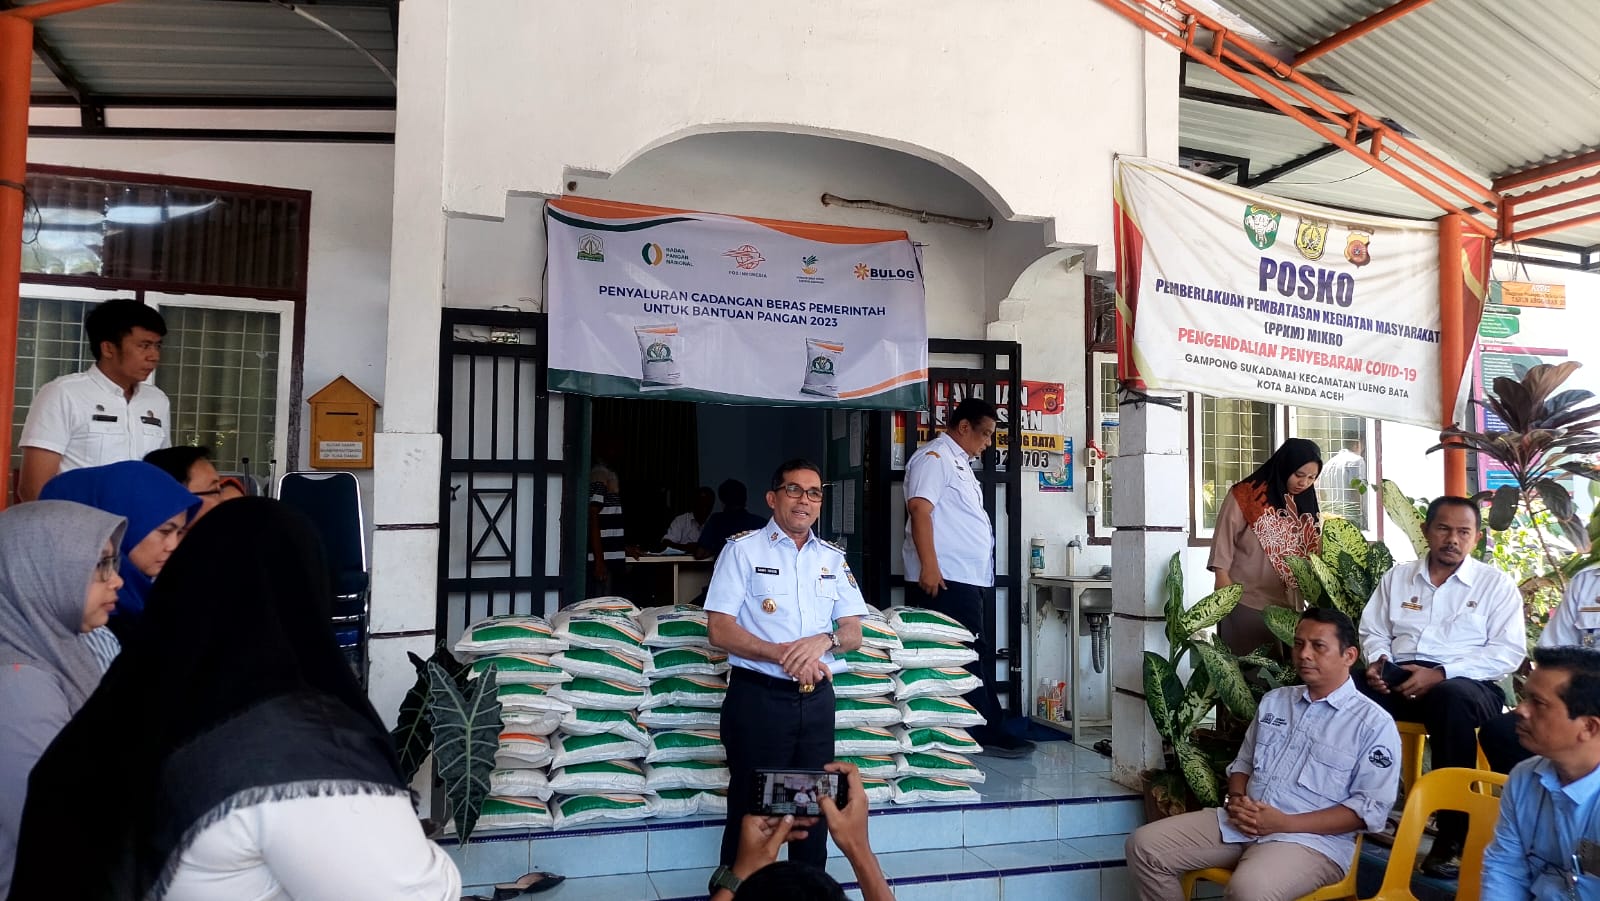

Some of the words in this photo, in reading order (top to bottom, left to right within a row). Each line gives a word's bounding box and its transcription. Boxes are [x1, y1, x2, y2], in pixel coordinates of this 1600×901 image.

[870, 268, 915, 279] BULOG
[1258, 256, 1355, 308] POSKO
[599, 285, 688, 301] PENYALURAN
[691, 292, 763, 308] CADANGAN
[766, 299, 806, 312] BERAS
[809, 302, 886, 316] PEMERINTAH
[643, 302, 689, 316] UNTUK
[692, 305, 754, 321] BANTUAN
[757, 311, 807, 325] PANGAN
[810, 316, 838, 327] 2023
[1155, 278, 1245, 309] PEMBERLAKUAN
[1246, 296, 1321, 323] PEMBATASAN
[1322, 310, 1373, 332] KEGIATAN
[1375, 319, 1441, 344] MASYARAKAT
[1264, 321, 1305, 341] (PPKM)
[1307, 328, 1343, 347] MIKRO
[1178, 327, 1278, 358] PENGENDALIAN
[1280, 345, 1363, 372] PENYEBARAN
[1365, 360, 1417, 382] COVID-19
[1184, 353, 1238, 370] GAMPONG
[1240, 363, 1297, 381] SUKADAMAI
[1299, 372, 1356, 390] KECAMATAN
[1358, 382, 1386, 395] LUENG
[1388, 387, 1409, 399] BATA
[1257, 379, 1282, 394] KOTA
[1285, 382, 1317, 397] BANDA
[1319, 389, 1344, 401] ACEH
[1031, 435, 1056, 448] BATA
